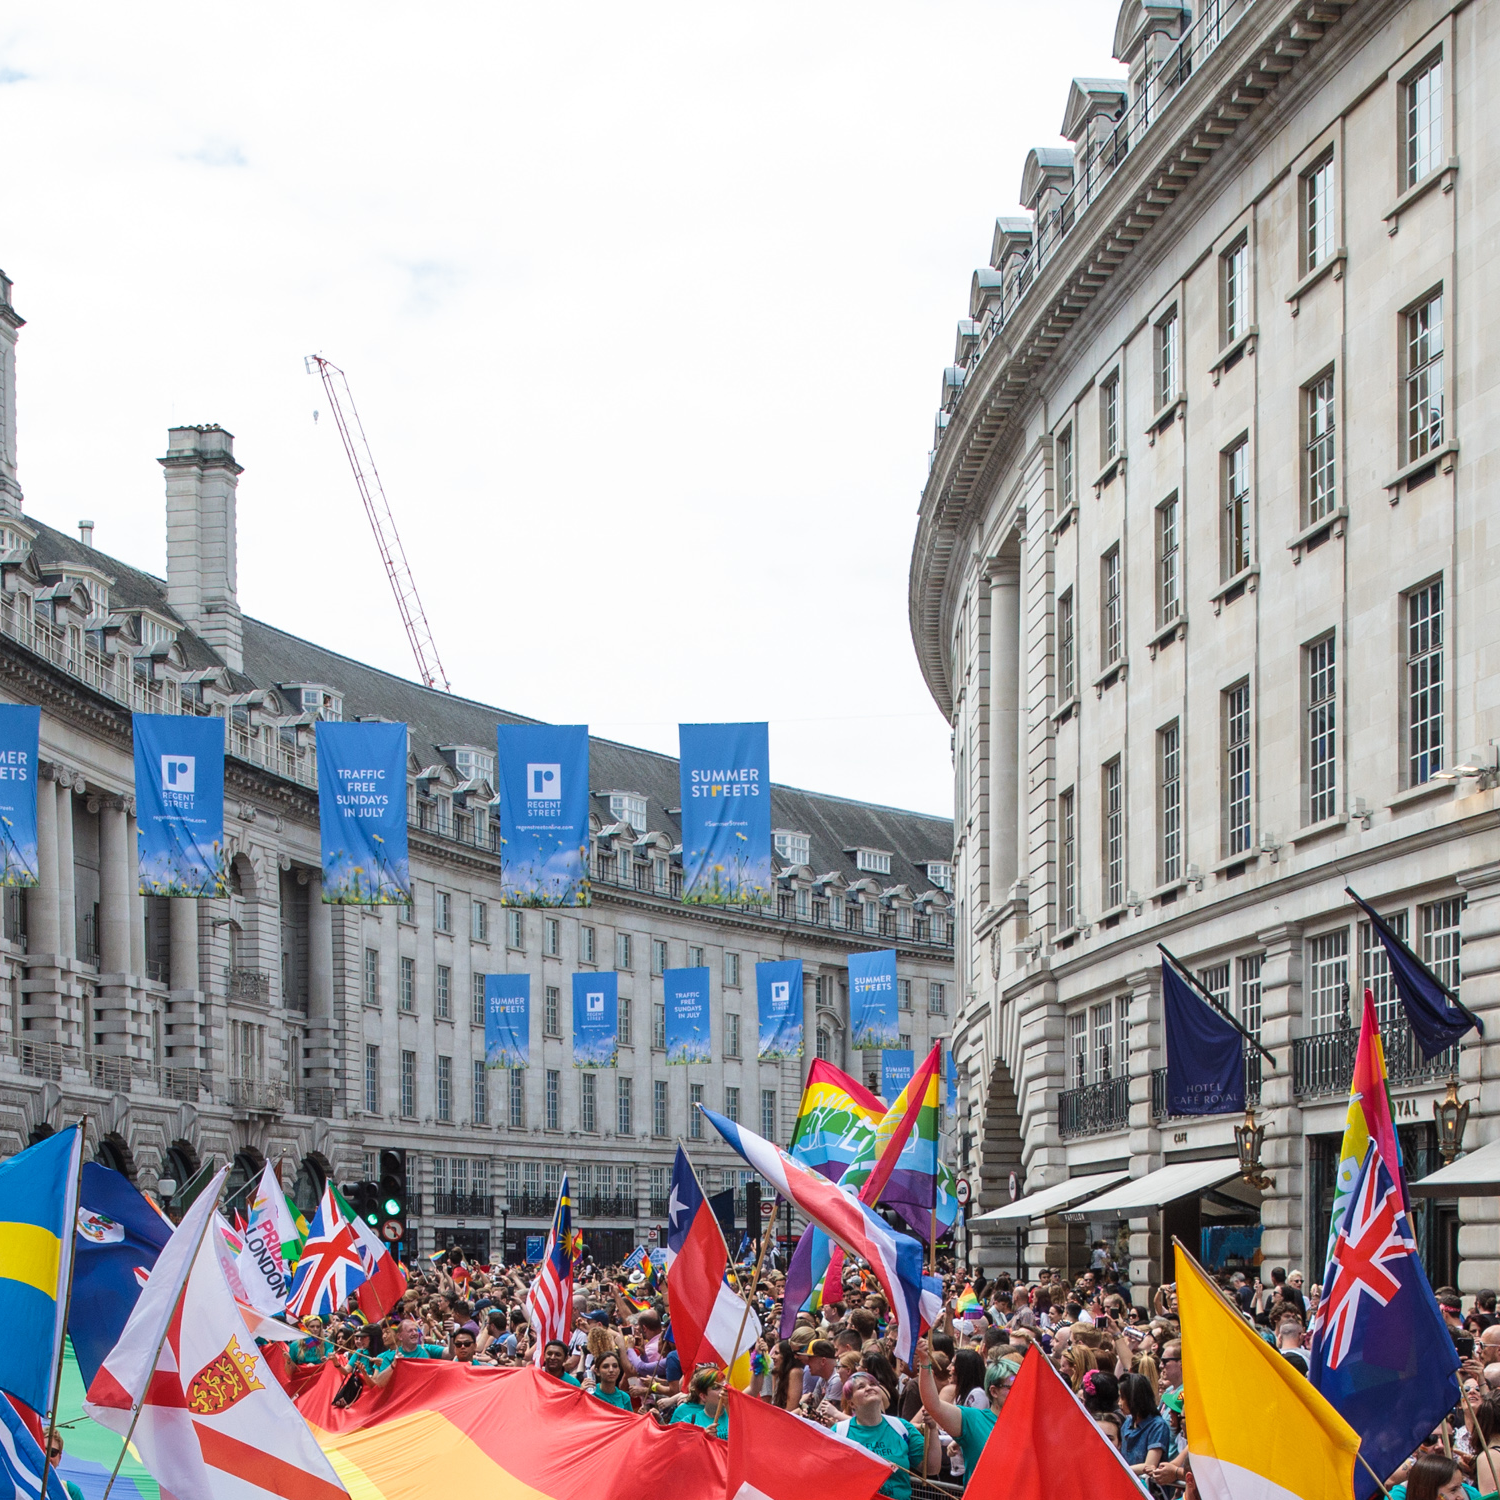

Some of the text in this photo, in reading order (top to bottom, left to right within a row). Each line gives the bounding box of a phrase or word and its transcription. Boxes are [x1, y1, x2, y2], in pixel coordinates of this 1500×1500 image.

[337, 769, 385, 780] TRAFFIC
[691, 768, 760, 783] SUMMER
[347, 782, 376, 793] FREE
[162, 791, 195, 801] REGENT
[336, 795, 389, 806] SUNDAYS
[162, 800, 195, 810] STREET
[527, 800, 561, 809] REGENT
[344, 807, 385, 818] IN JULY
[527, 809, 561, 817] STREET
[854, 974, 892, 985] SUMMER
[490, 997, 525, 1005] SUMMER
[1186, 1083, 1223, 1093] HOTEL
[1204, 1093, 1238, 1104] ROYAL
[1064, 1213, 1085, 1221] PAPILLON
[246, 1227, 288, 1299] LONDON
